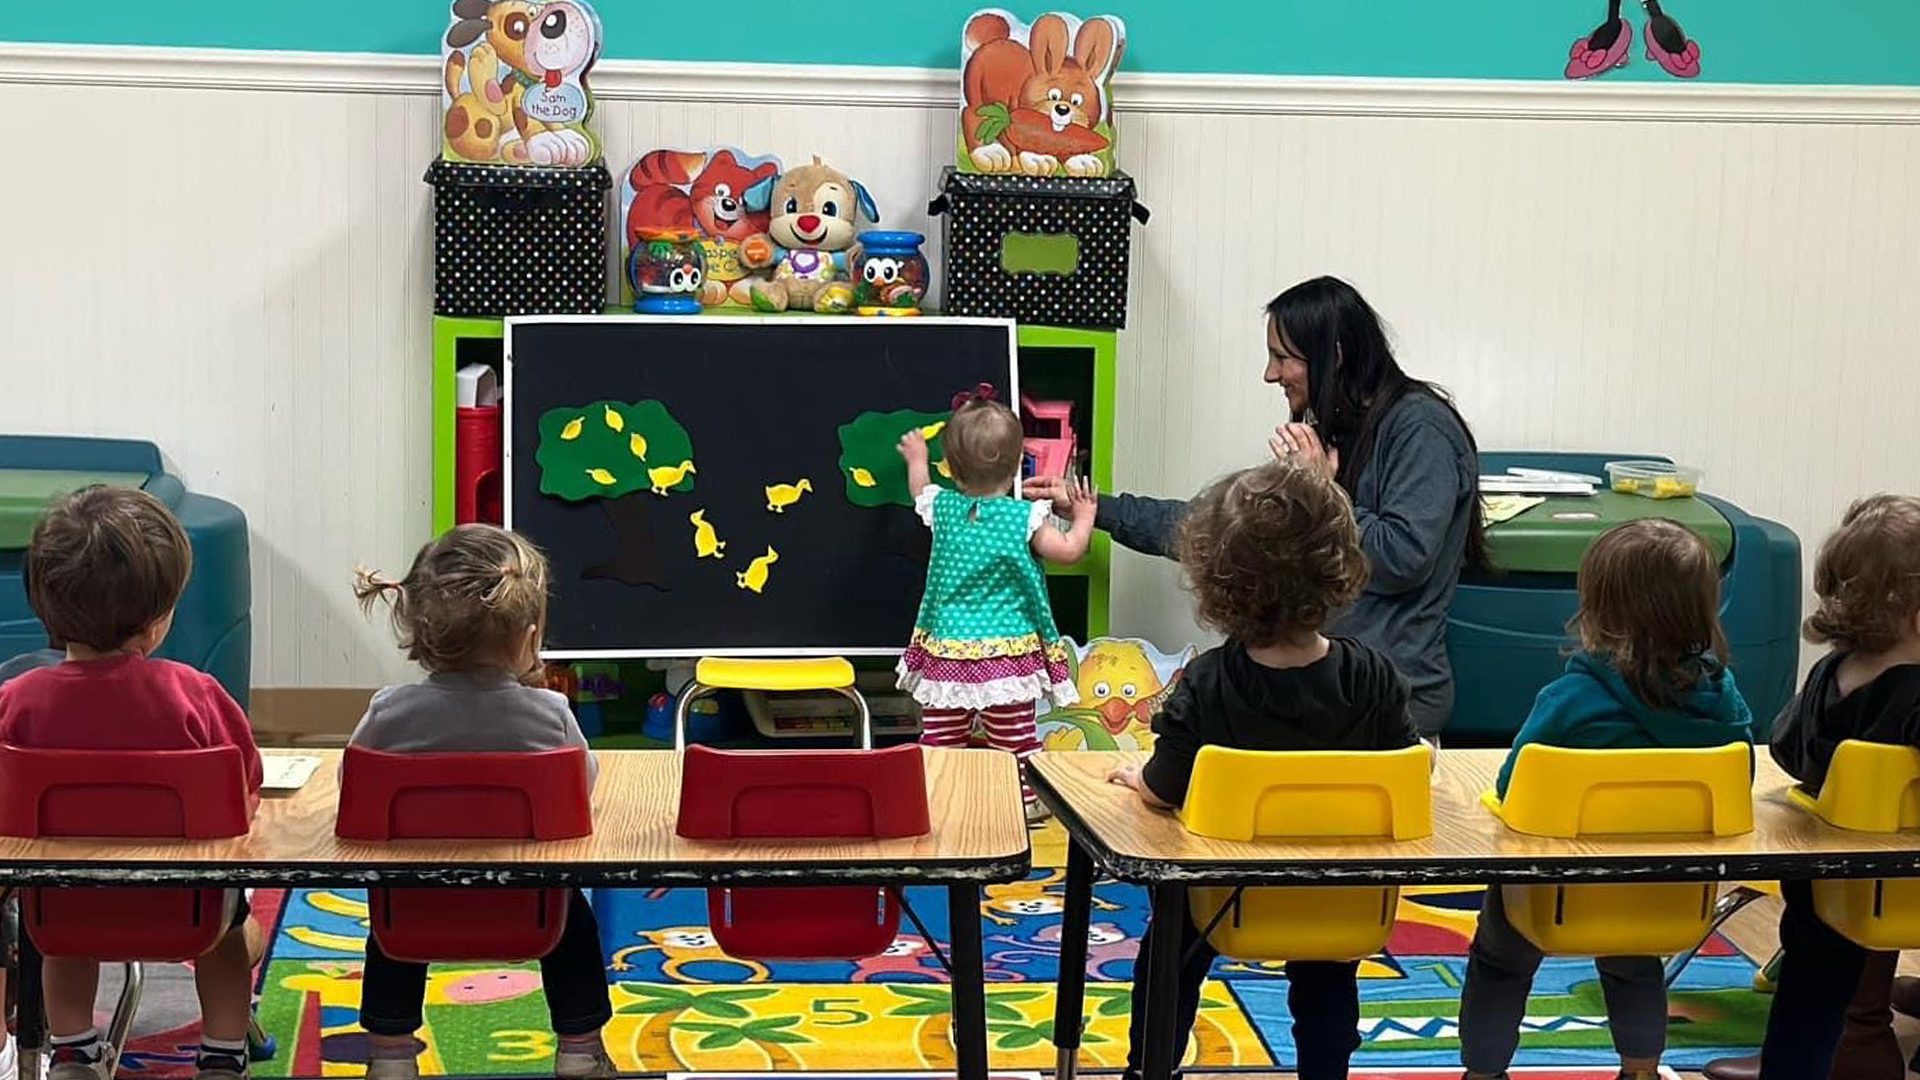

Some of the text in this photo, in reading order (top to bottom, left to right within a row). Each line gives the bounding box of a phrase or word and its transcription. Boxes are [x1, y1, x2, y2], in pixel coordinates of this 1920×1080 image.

[541, 92, 567, 103] Sam
[532, 104, 577, 118] the Dog
[812, 997, 870, 1026] 5
[487, 1028, 555, 1062] 3
